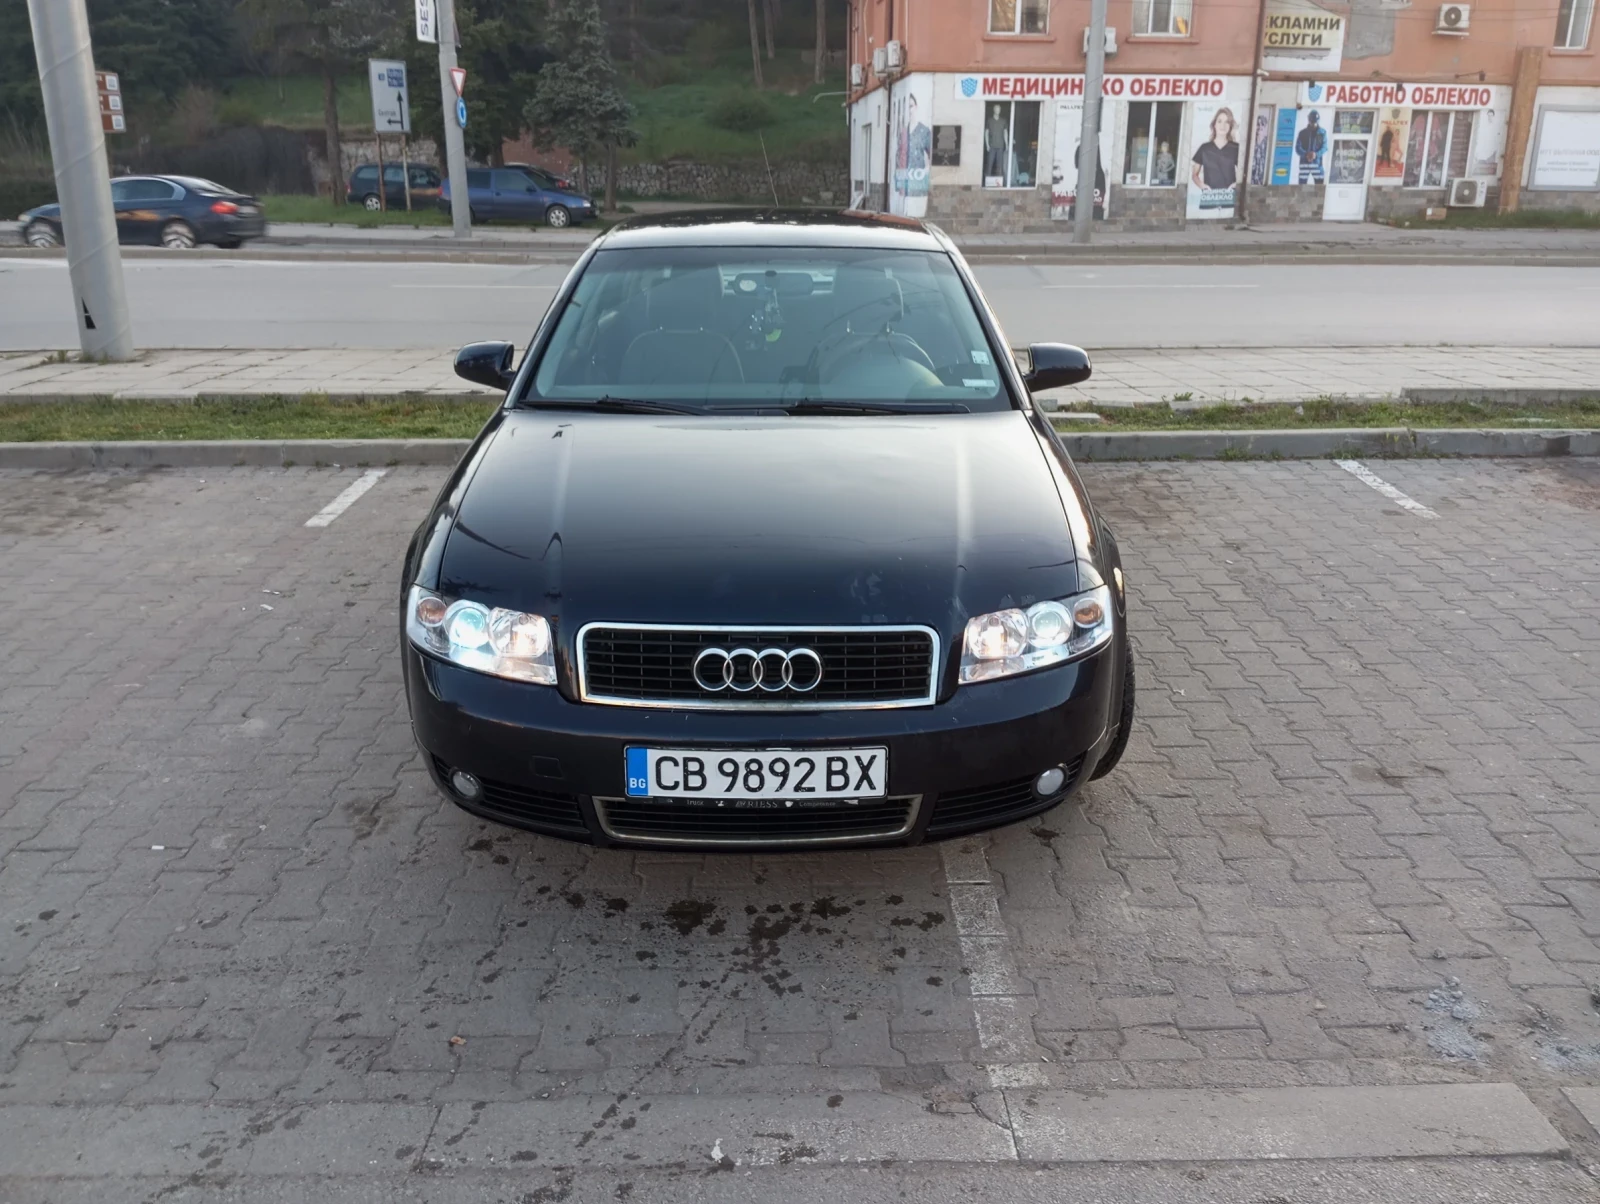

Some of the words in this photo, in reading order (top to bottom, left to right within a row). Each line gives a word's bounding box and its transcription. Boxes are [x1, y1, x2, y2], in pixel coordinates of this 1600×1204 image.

[1266, 15, 1341, 31] КЛАМНИ
[1264, 31, 1323, 46] СЛУГИ
[982, 77, 1125, 99] МЕДИЦИНКО
[1129, 78, 1224, 97] ОБЛЕКЛО
[1325, 84, 1407, 105] РАБОТНО
[1411, 86, 1492, 106] ОБЛЕКЛО
[629, 777, 647, 789] BG
[654, 755, 708, 793] CB
[717, 756, 816, 793] 9892
[825, 754, 878, 791] BX
